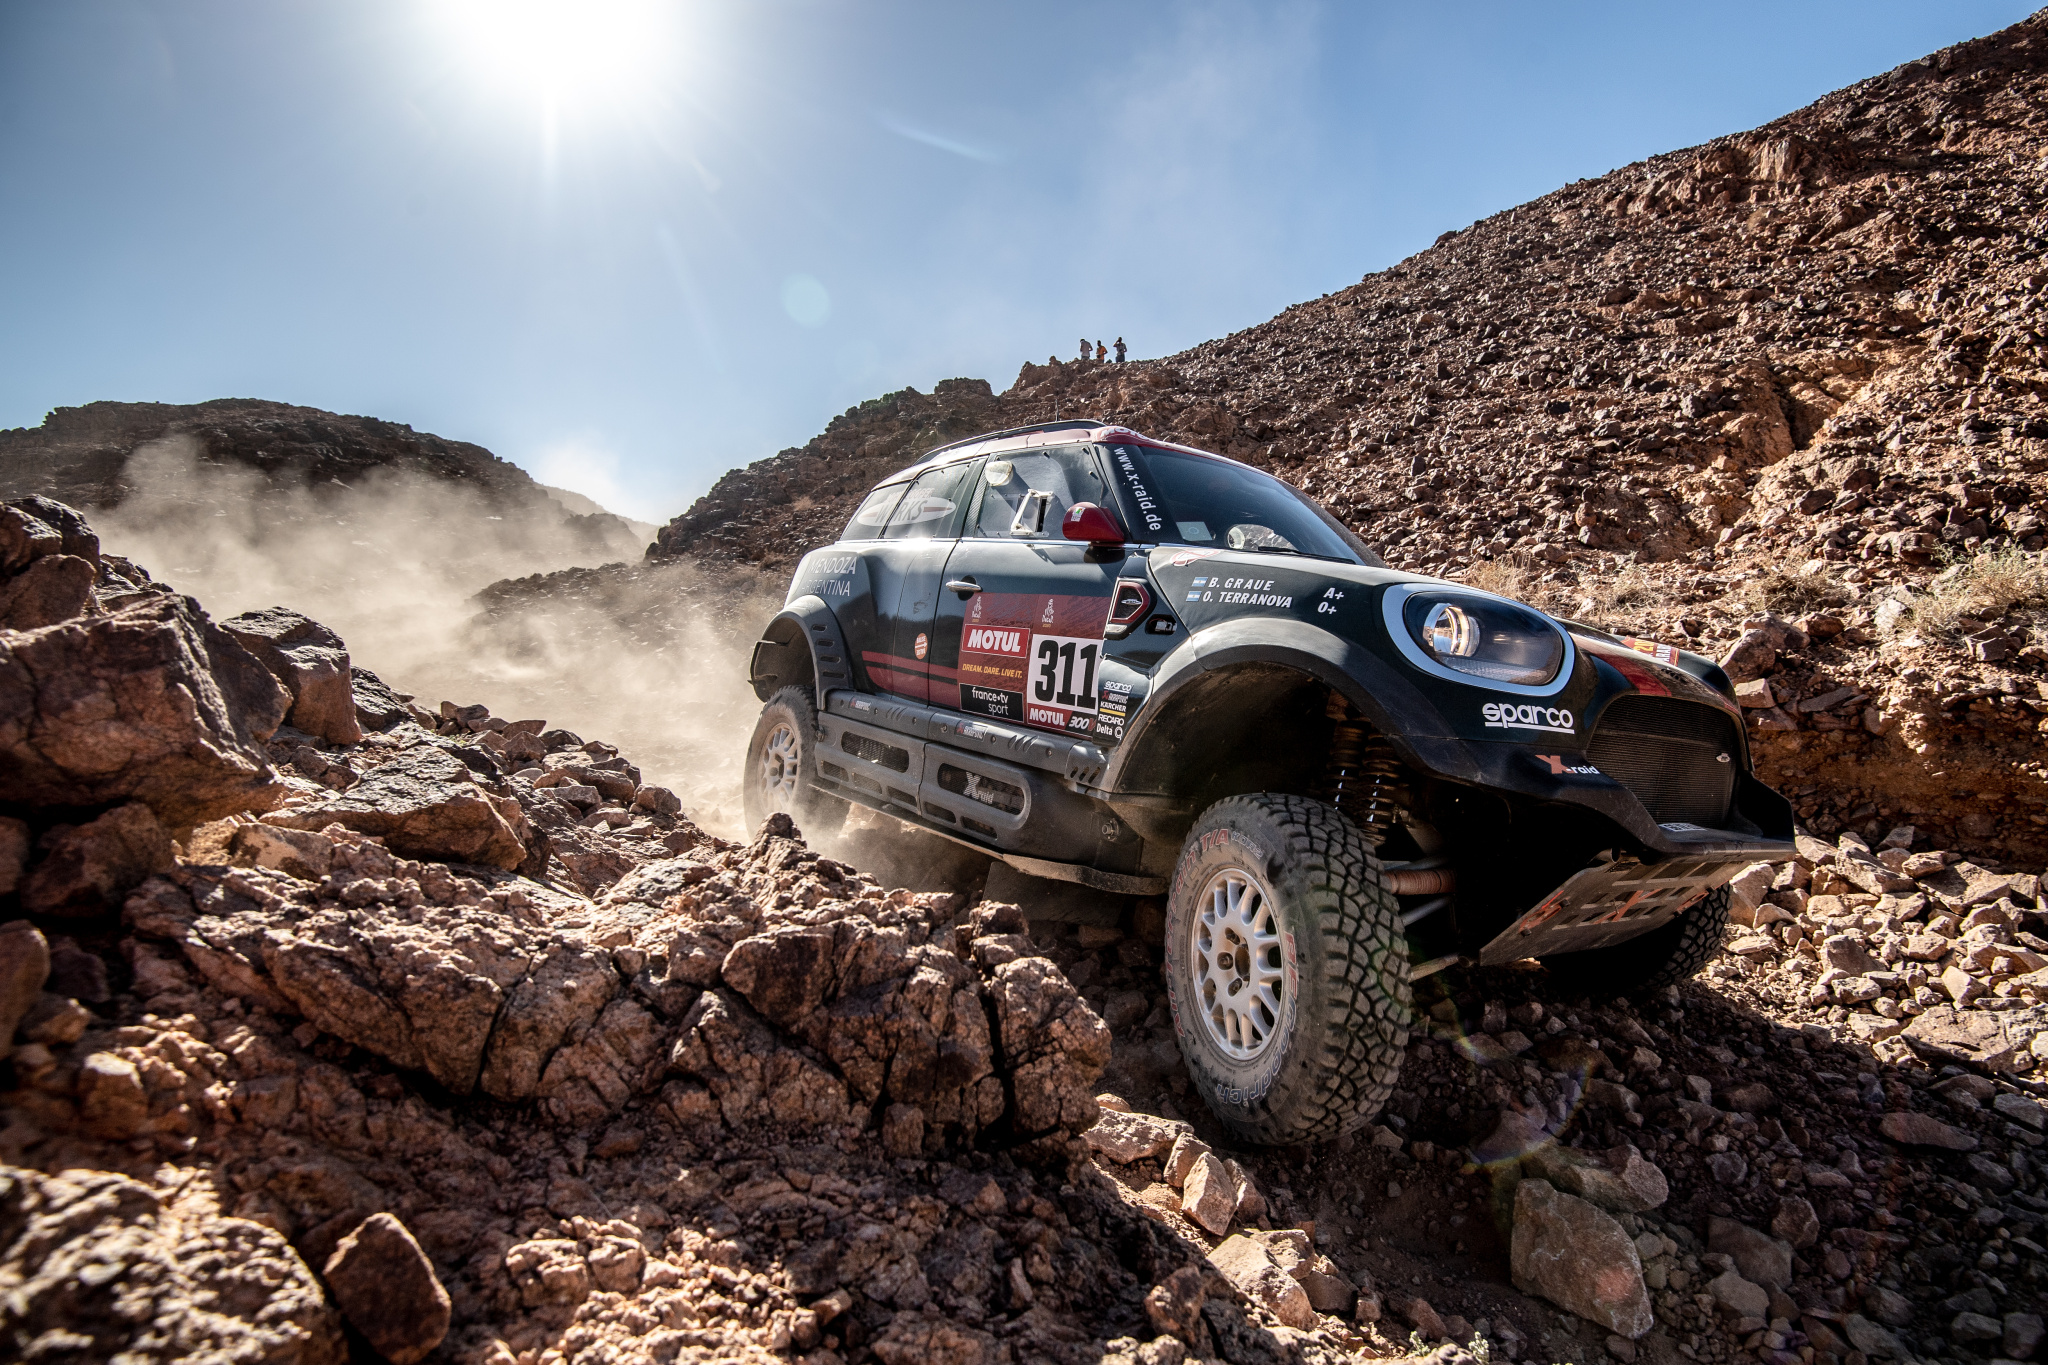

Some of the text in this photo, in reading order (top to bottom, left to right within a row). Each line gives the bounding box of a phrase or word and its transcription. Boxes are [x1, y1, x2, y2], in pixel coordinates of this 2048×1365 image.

[1113, 447, 1162, 531] www.x-raid.de
[874, 500, 928, 523] WRKS
[808, 556, 857, 575] MENDOZA
[1208, 577, 1275, 591] B. GRAUE
[1323, 587, 1345, 600] A+
[1218, 592, 1293, 608] TERRANOVA
[967, 629, 1021, 653] MOTUL
[962, 663, 983, 673] DREAM.
[983, 666, 1001, 676] DARE.
[1001, 668, 1015, 678] LIVE
[1034, 639, 1098, 710] 311
[1104, 681, 1133, 693] sparco
[988, 703, 1009, 716] sport
[1029, 707, 1066, 726] MOTUL
[1482, 703, 1575, 732] sparco
[1096, 723, 1113, 736] Delta
[1098, 714, 1125, 726] RECARO
[1535, 754, 1600, 775] X-raid
[1200, 828, 1229, 852] T/A
